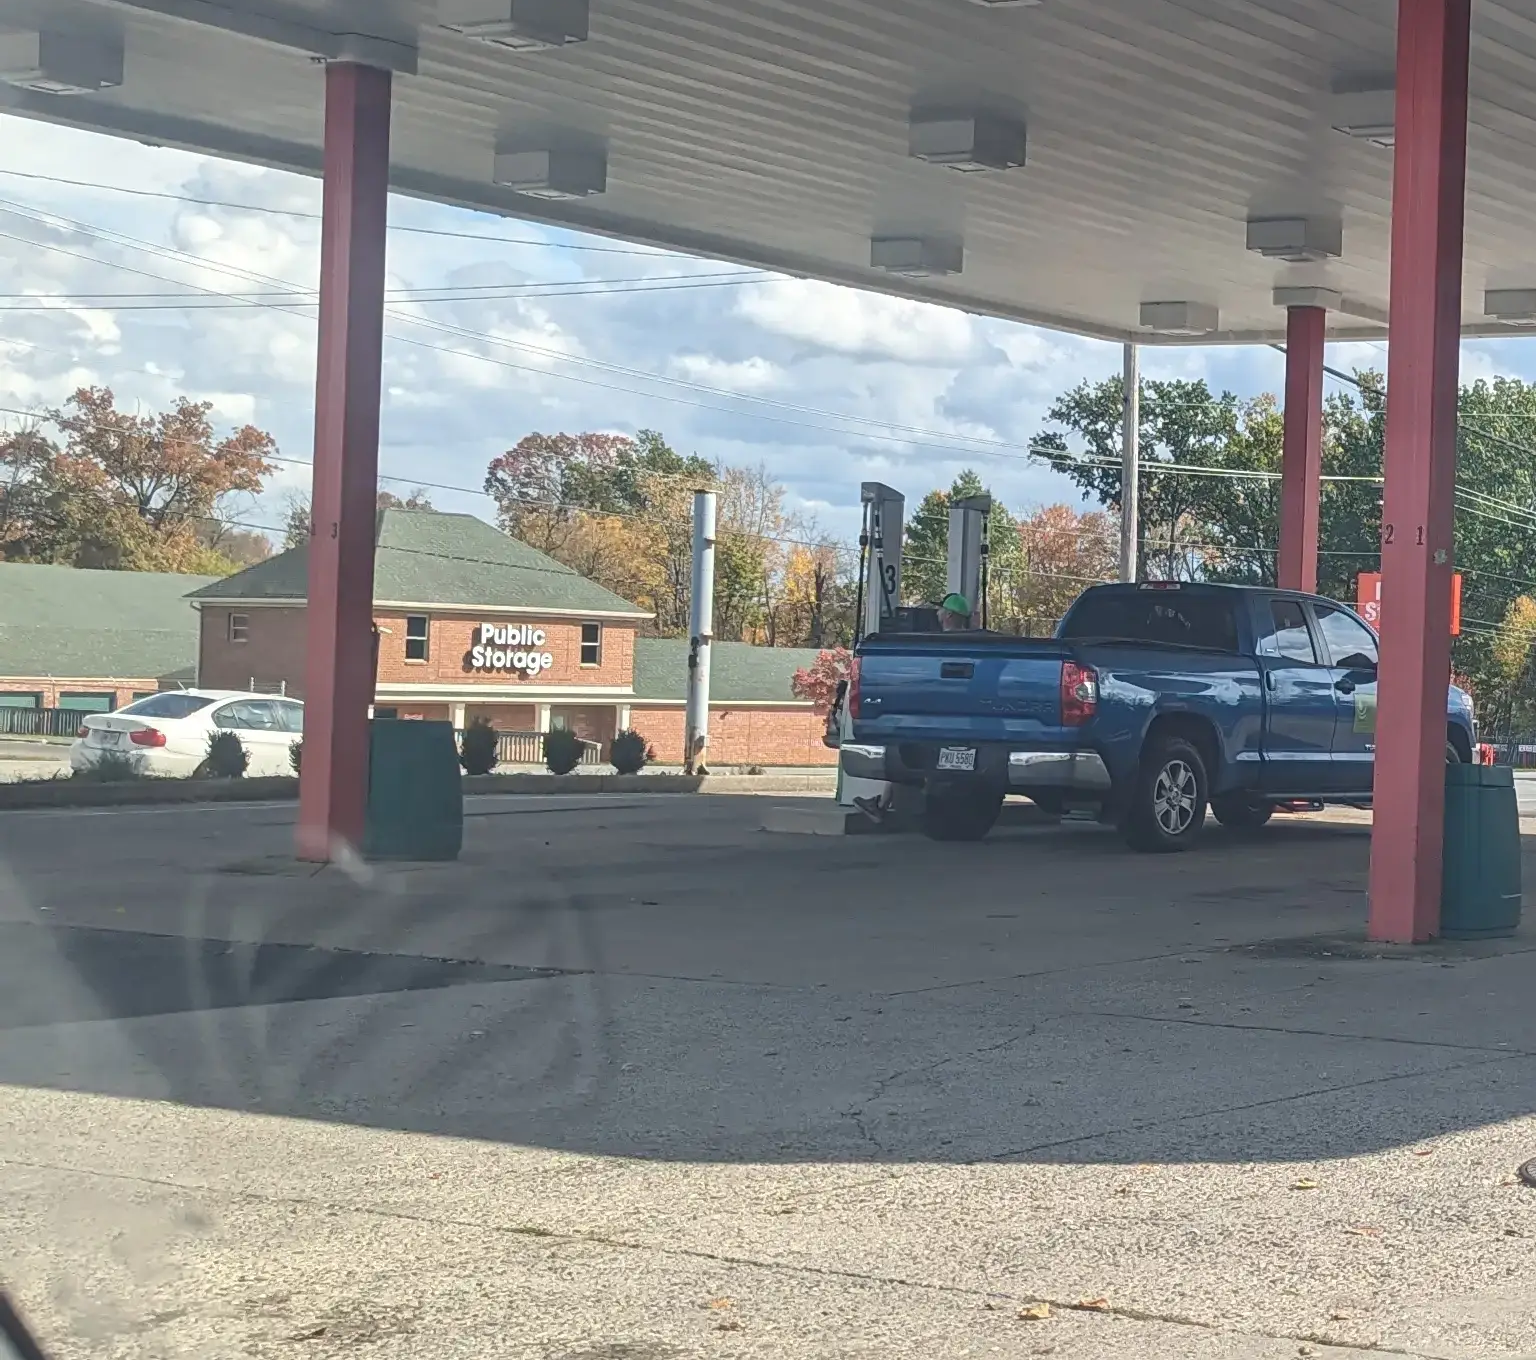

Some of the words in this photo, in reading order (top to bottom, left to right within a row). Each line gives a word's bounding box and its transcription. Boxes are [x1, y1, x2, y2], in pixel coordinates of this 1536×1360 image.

[1384, 524, 1394, 545] 2
[1416, 526, 1424, 545] 1
[885, 564, 896, 594] 3
[480, 623, 546, 646] Public
[472, 645, 553, 675] Storage
